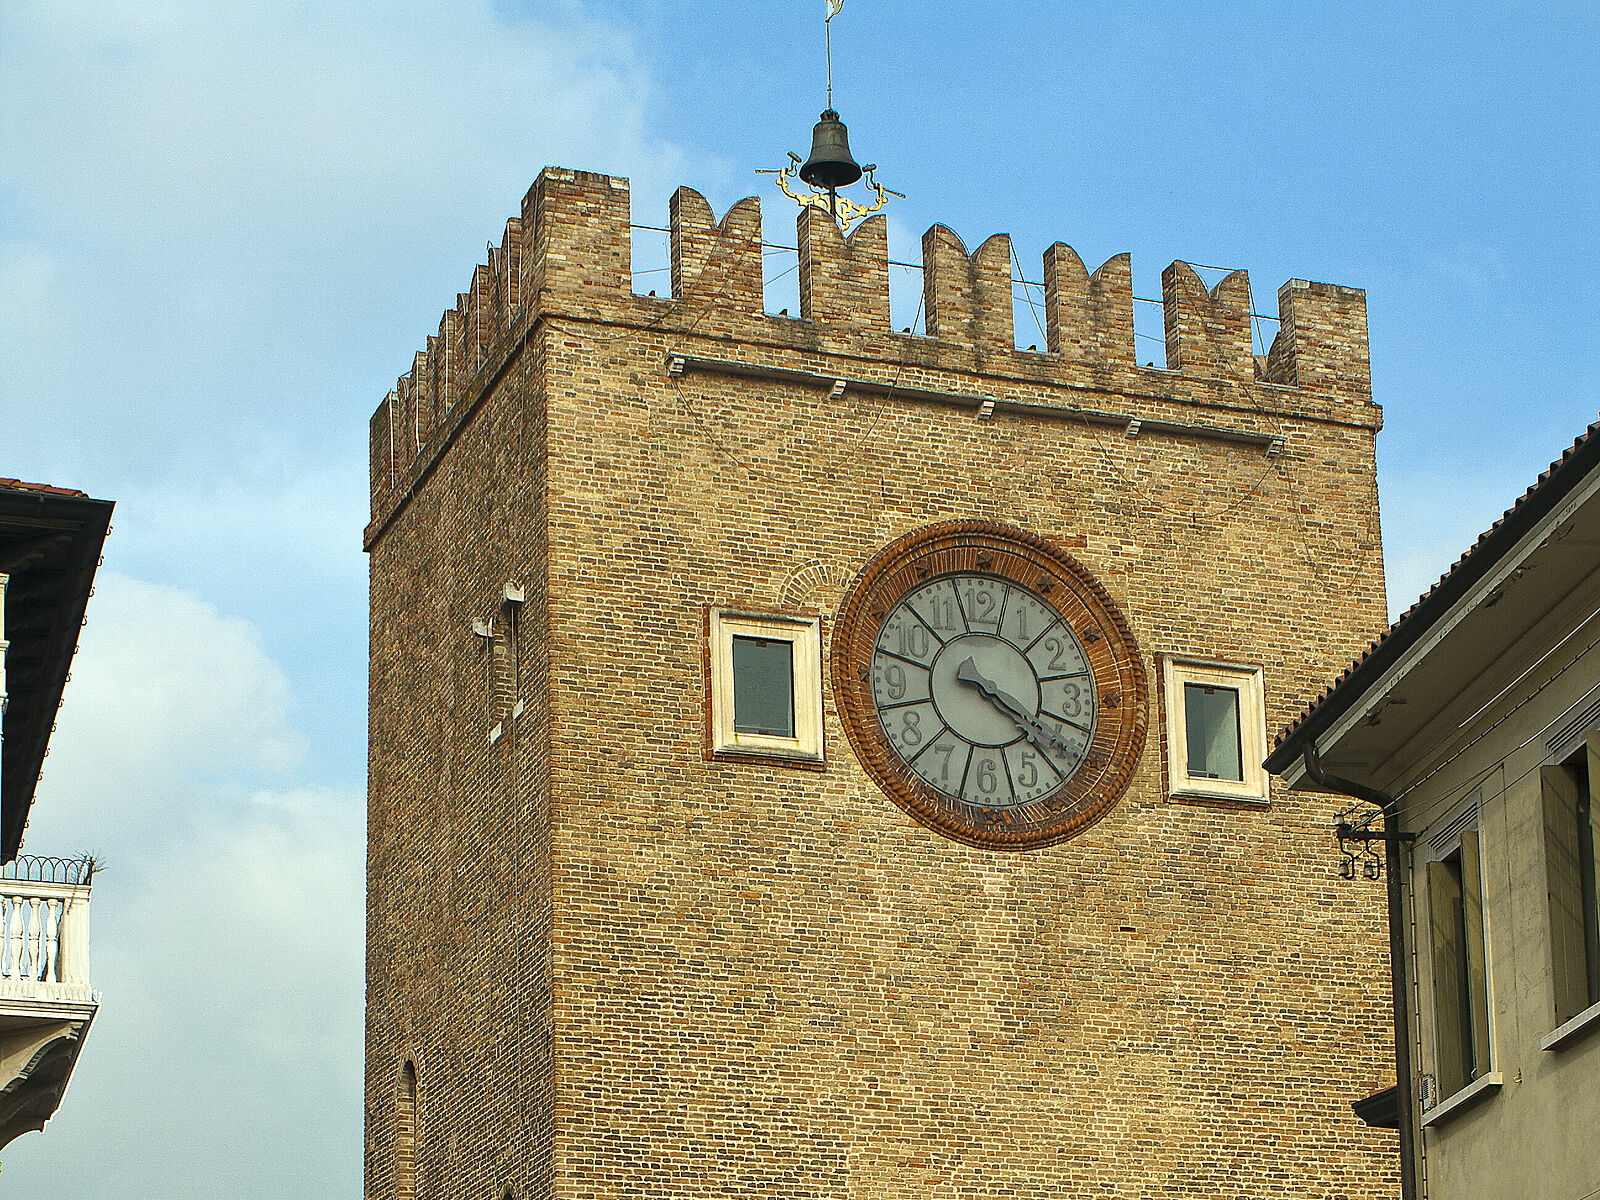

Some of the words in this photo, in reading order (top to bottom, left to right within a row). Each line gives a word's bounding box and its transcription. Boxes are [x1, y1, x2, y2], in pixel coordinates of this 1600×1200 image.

[930, 595, 956, 630] 11
[965, 588, 997, 624] 12
[1017, 607, 1030, 640] 1
[895, 621, 929, 658] 10
[1045, 637, 1067, 671] 2
[885, 665, 906, 699] 9
[1062, 682, 1082, 718] 3
[901, 711, 922, 745] 8
[935, 744, 955, 780] 7
[976, 759, 997, 794] 6
[1018, 751, 1038, 787] 5
